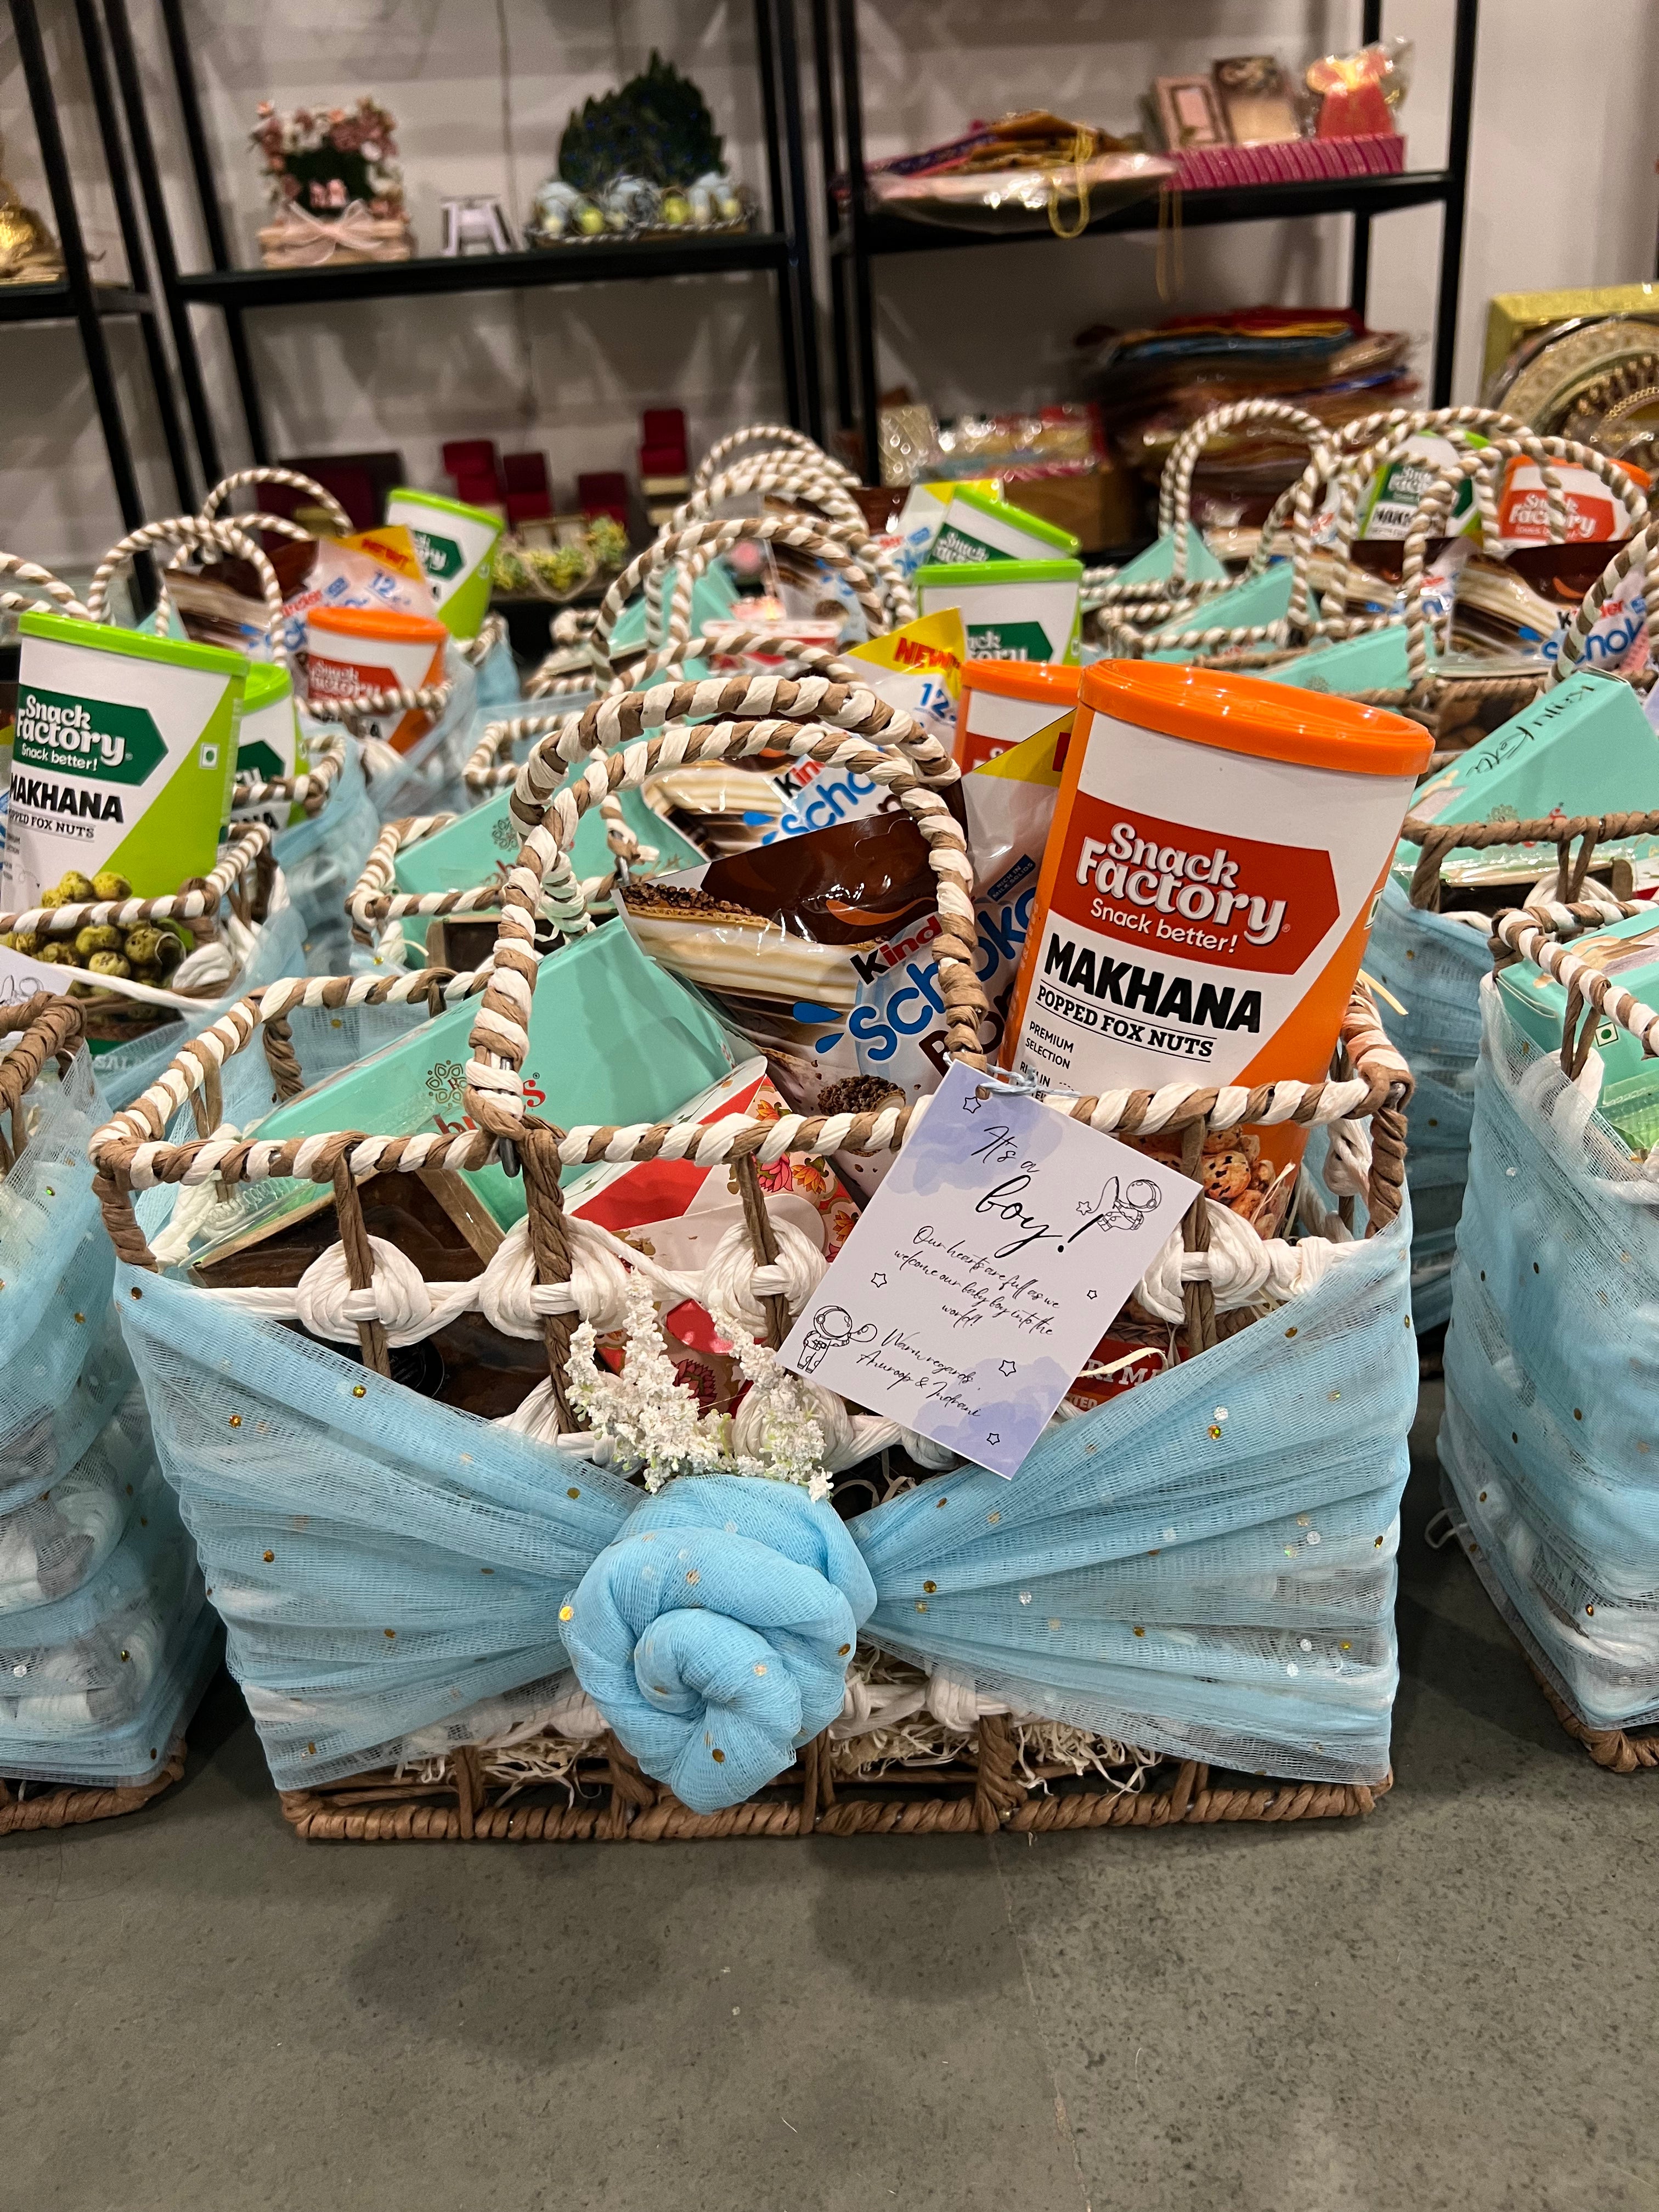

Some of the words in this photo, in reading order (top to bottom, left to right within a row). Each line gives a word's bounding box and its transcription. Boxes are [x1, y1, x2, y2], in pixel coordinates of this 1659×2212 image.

[26, 695, 92, 730] Snack
[16, 708, 126, 767] Factory
[21, 742, 49, 761] Snack
[51, 751, 98, 772] better!
[10, 772, 124, 823] MAKHANA
[31, 815, 53, 831] FOX
[55, 822, 95, 839] NUTS
[1107, 822, 1240, 889] Snack
[1076, 836, 1289, 946] Factory
[1090, 898, 1153, 934] Snack
[1155, 918, 1238, 953] better!
[1043, 932, 1262, 1034] MAKHANA
[1029, 1020, 1074, 1053] PREMIUM
[1037, 985, 1098, 1026] POPPED
[1101, 1017, 1144, 1045] FOX
[1147, 1029, 1214, 1057] NUTS
[1025, 1037, 1071, 1070] SELECTION
[1039, 1074, 1051, 1087] IN
[970, 1126, 1018, 1164] It's
[1020, 1160, 1040, 1173] a
[975, 1175, 1104, 1259] boy!
[913, 1226, 946, 1249] Our
[946, 1240, 990, 1273] hearts
[984, 1267, 1006, 1281] are
[998, 1274, 1039, 1300] full
[1027, 1290, 1043, 1301] as
[1044, 1297, 1060, 1308] we
[894, 1250, 939, 1276] welcome
[939, 1274, 962, 1288] our
[962, 1282, 990, 1307] baby
[989, 1296, 1011, 1318] boy
[1011, 1309, 1037, 1329] into
[1028, 1316, 1054, 1335] the
[941, 1304, 984, 1329] world!
[881, 1328, 926, 1361] Warm
[915, 1376, 930, 1389] &
